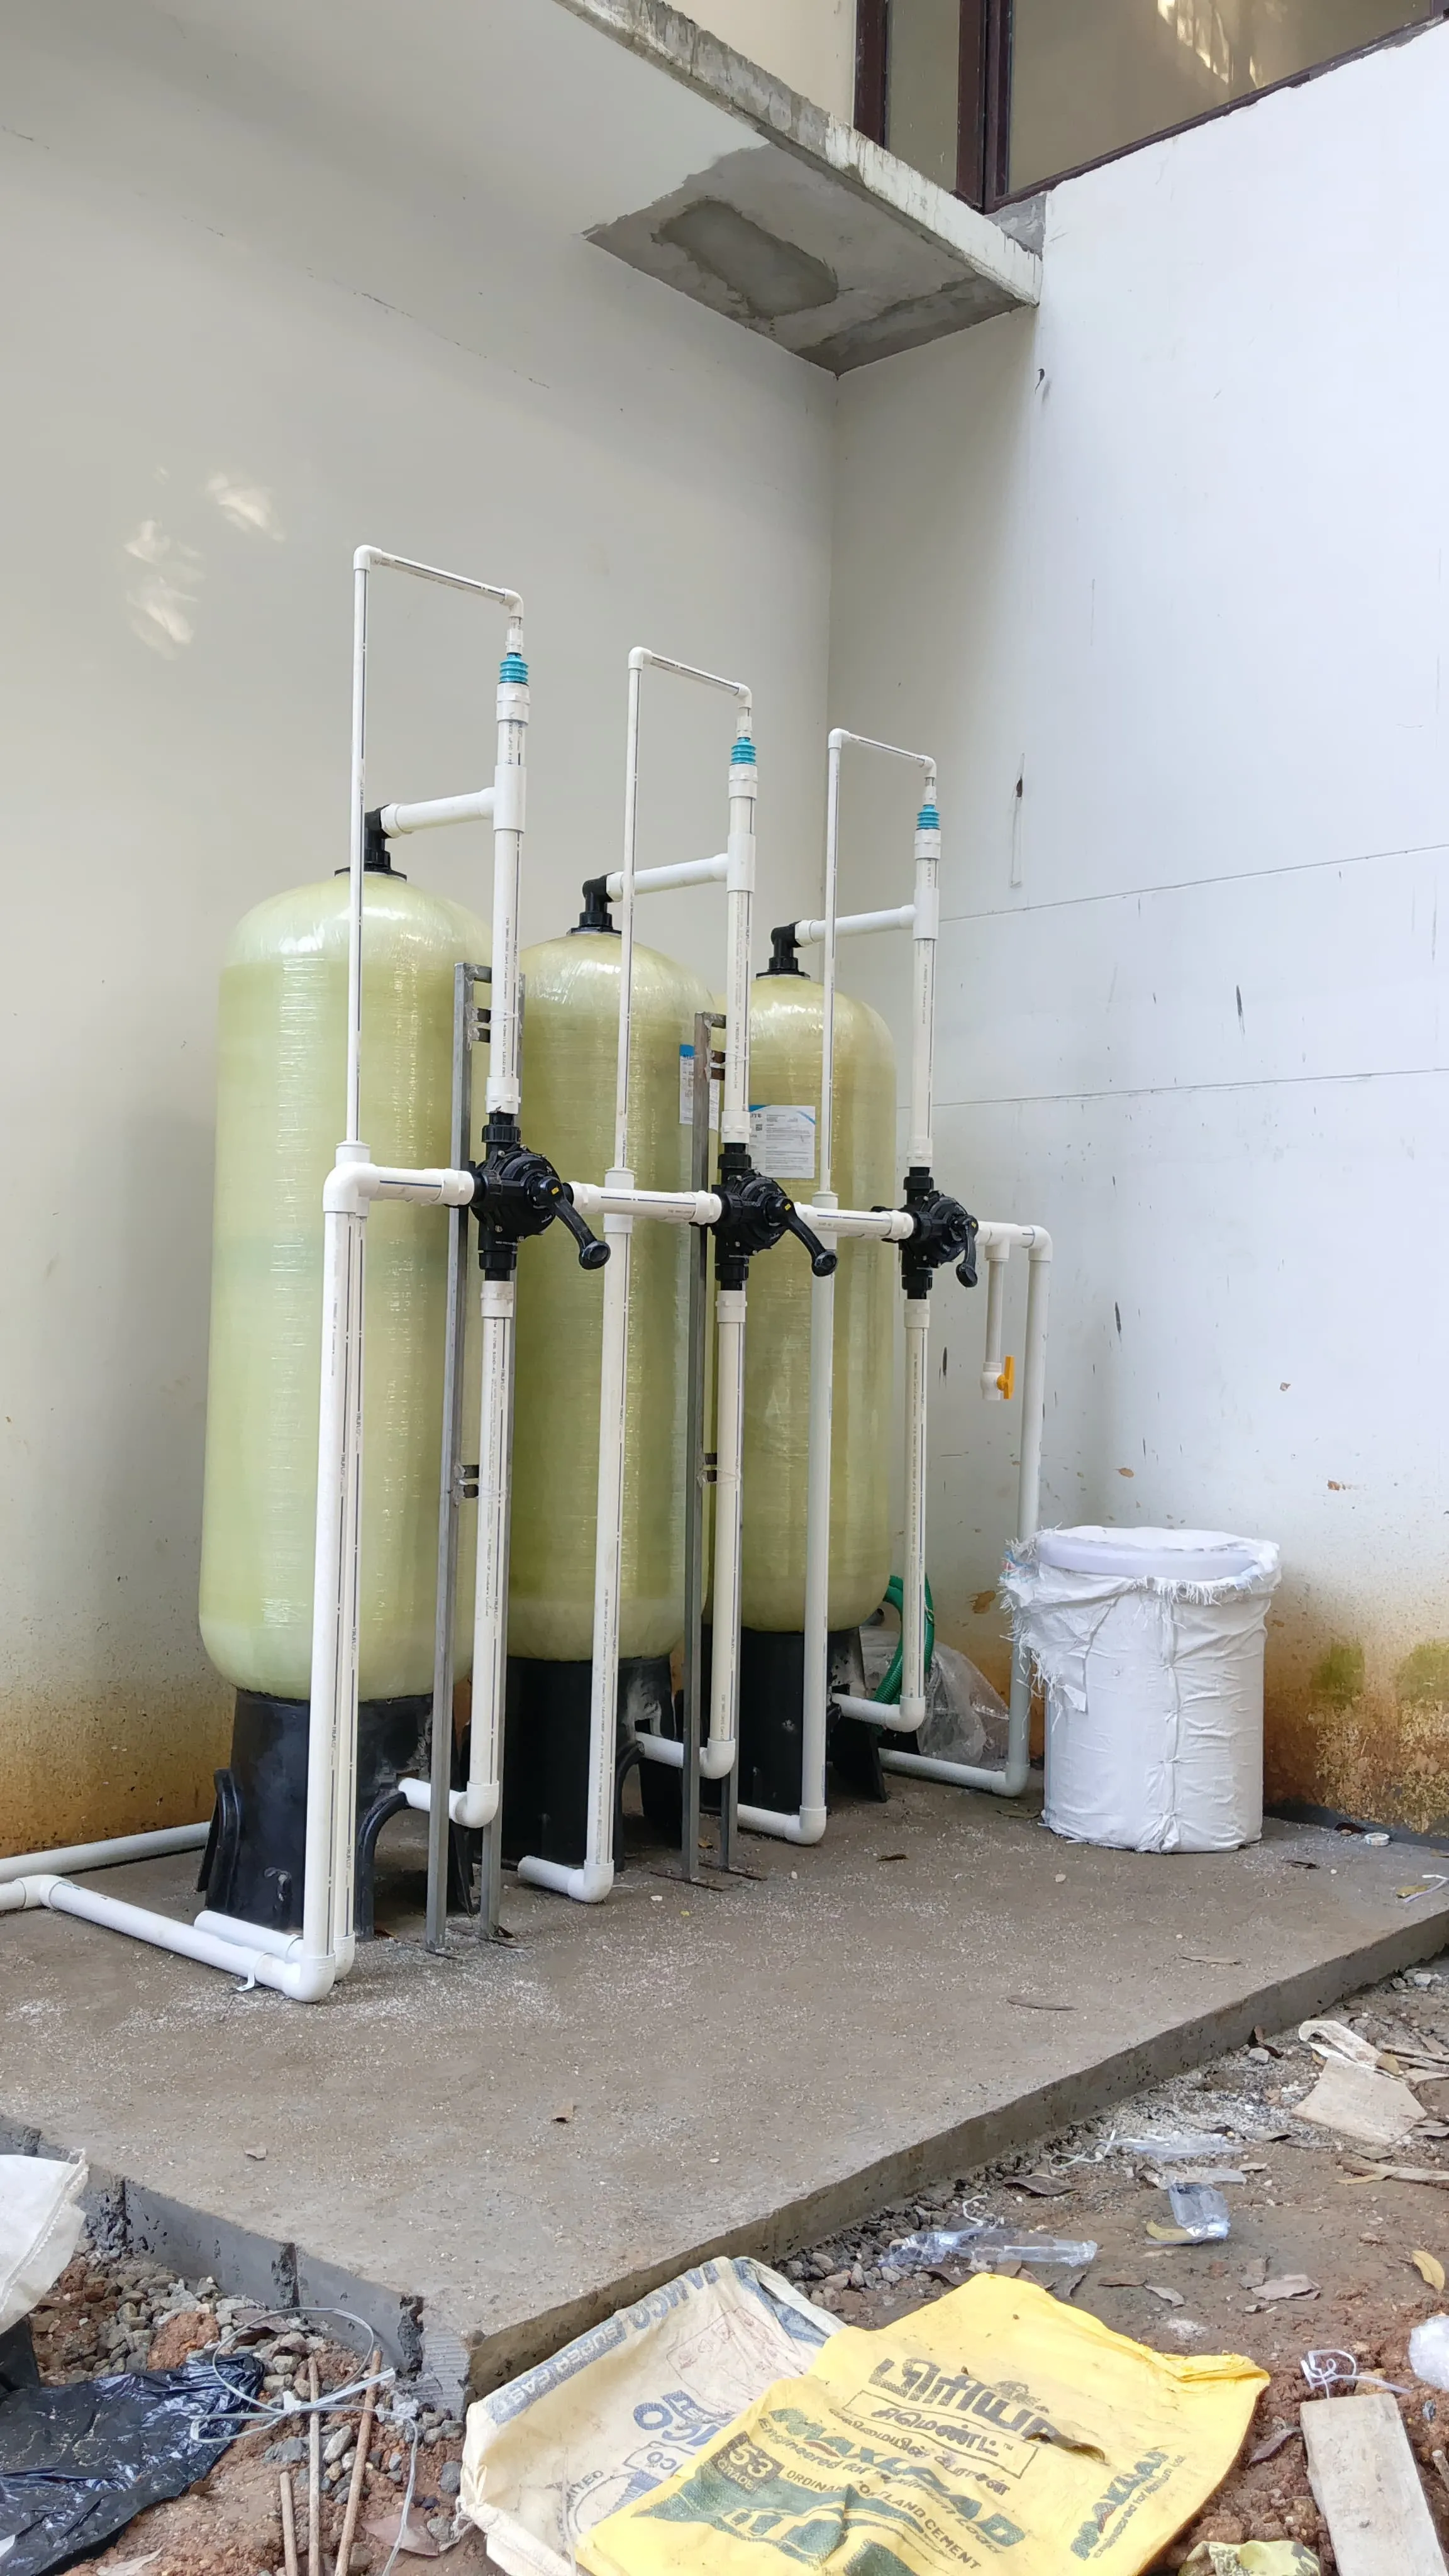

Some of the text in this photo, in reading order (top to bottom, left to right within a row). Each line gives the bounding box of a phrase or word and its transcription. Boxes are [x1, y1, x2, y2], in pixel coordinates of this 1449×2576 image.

[555, 2327, 619, 2373] SUPER
[717, 2458, 754, 2490] GRADE
[728, 2442, 774, 2478] 53
[786, 2469, 846, 2493] ORDINAR
[924, 2517, 982, 2570] CEMENT
